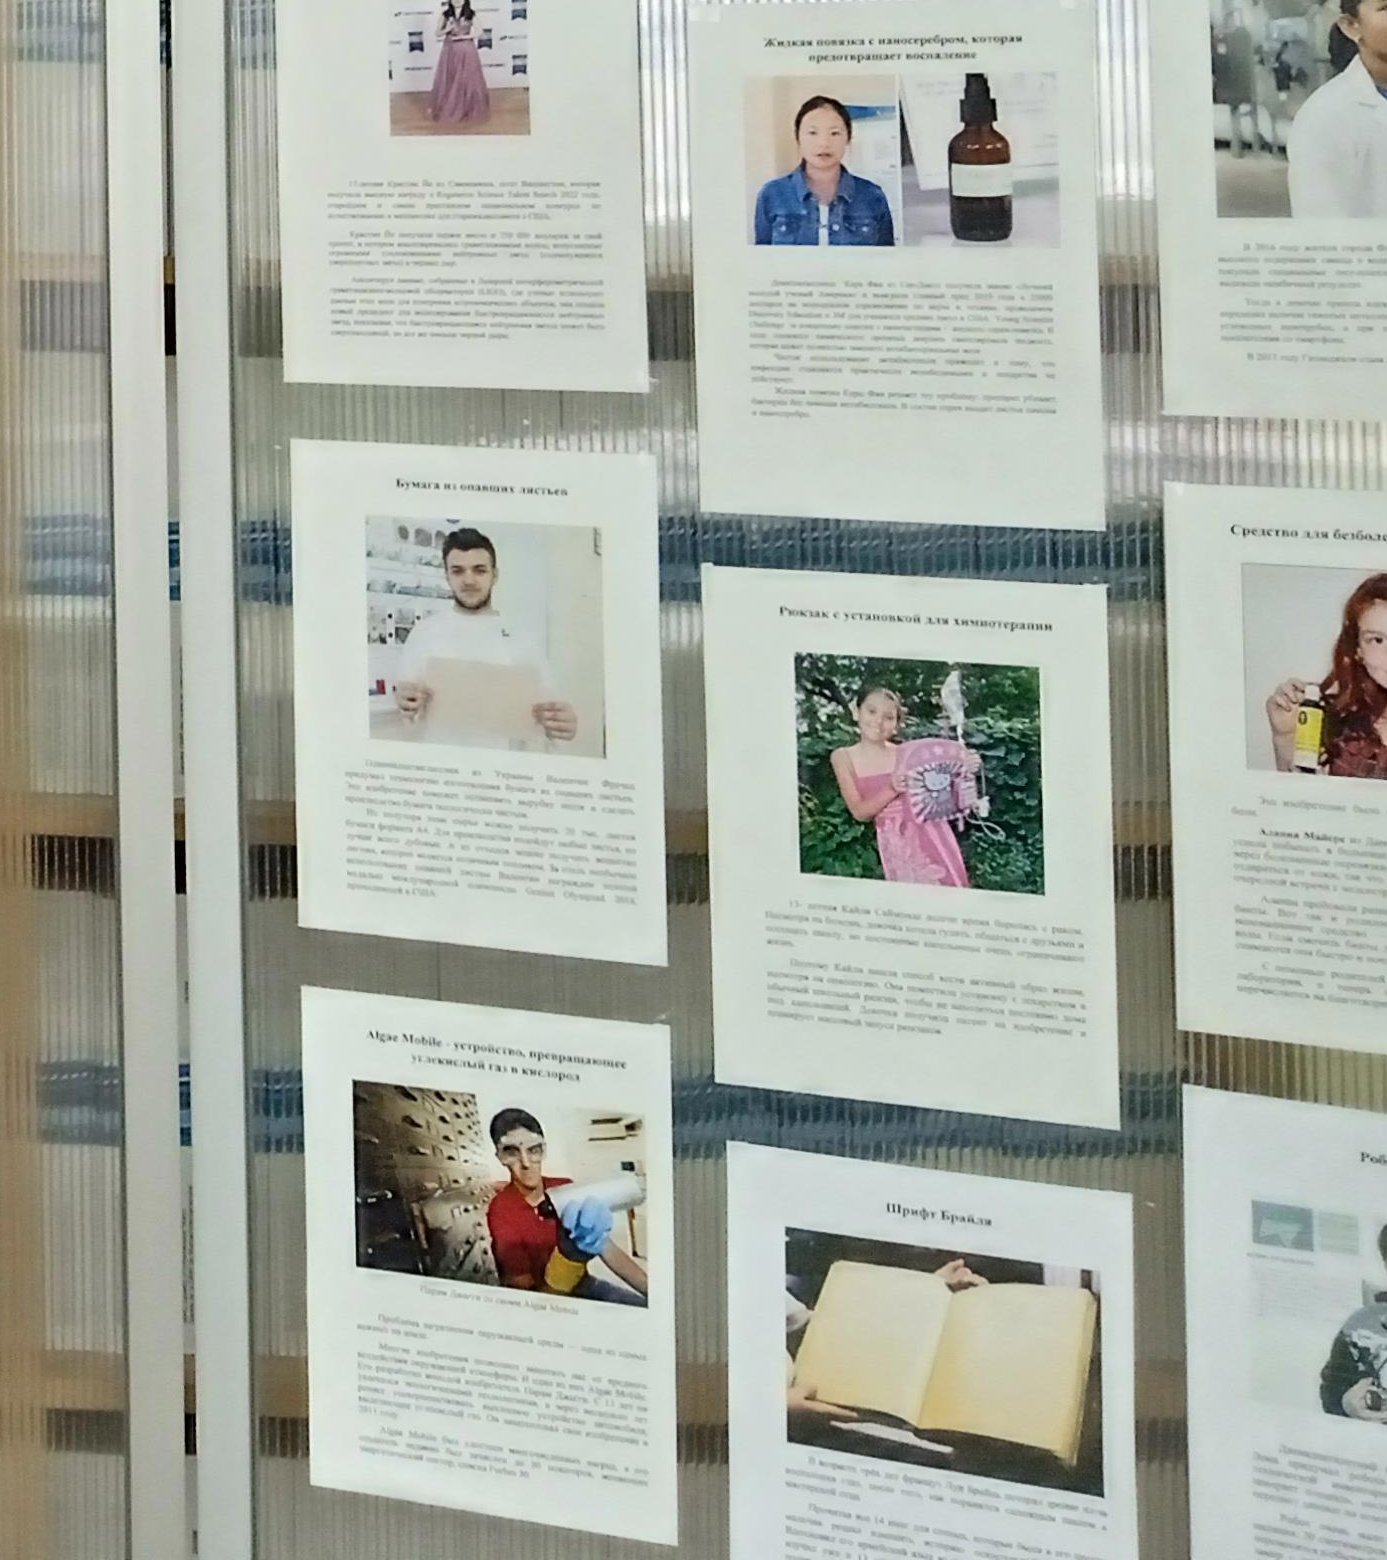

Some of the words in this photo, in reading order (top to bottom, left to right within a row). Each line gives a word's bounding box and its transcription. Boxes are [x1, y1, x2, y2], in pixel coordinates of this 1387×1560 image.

[1230, 524, 1298, 538] Средство
[1302, 531, 1329, 539] для
[886, 1203, 936, 1220] Шрифт
[941, 1210, 992, 1226] Брайля
